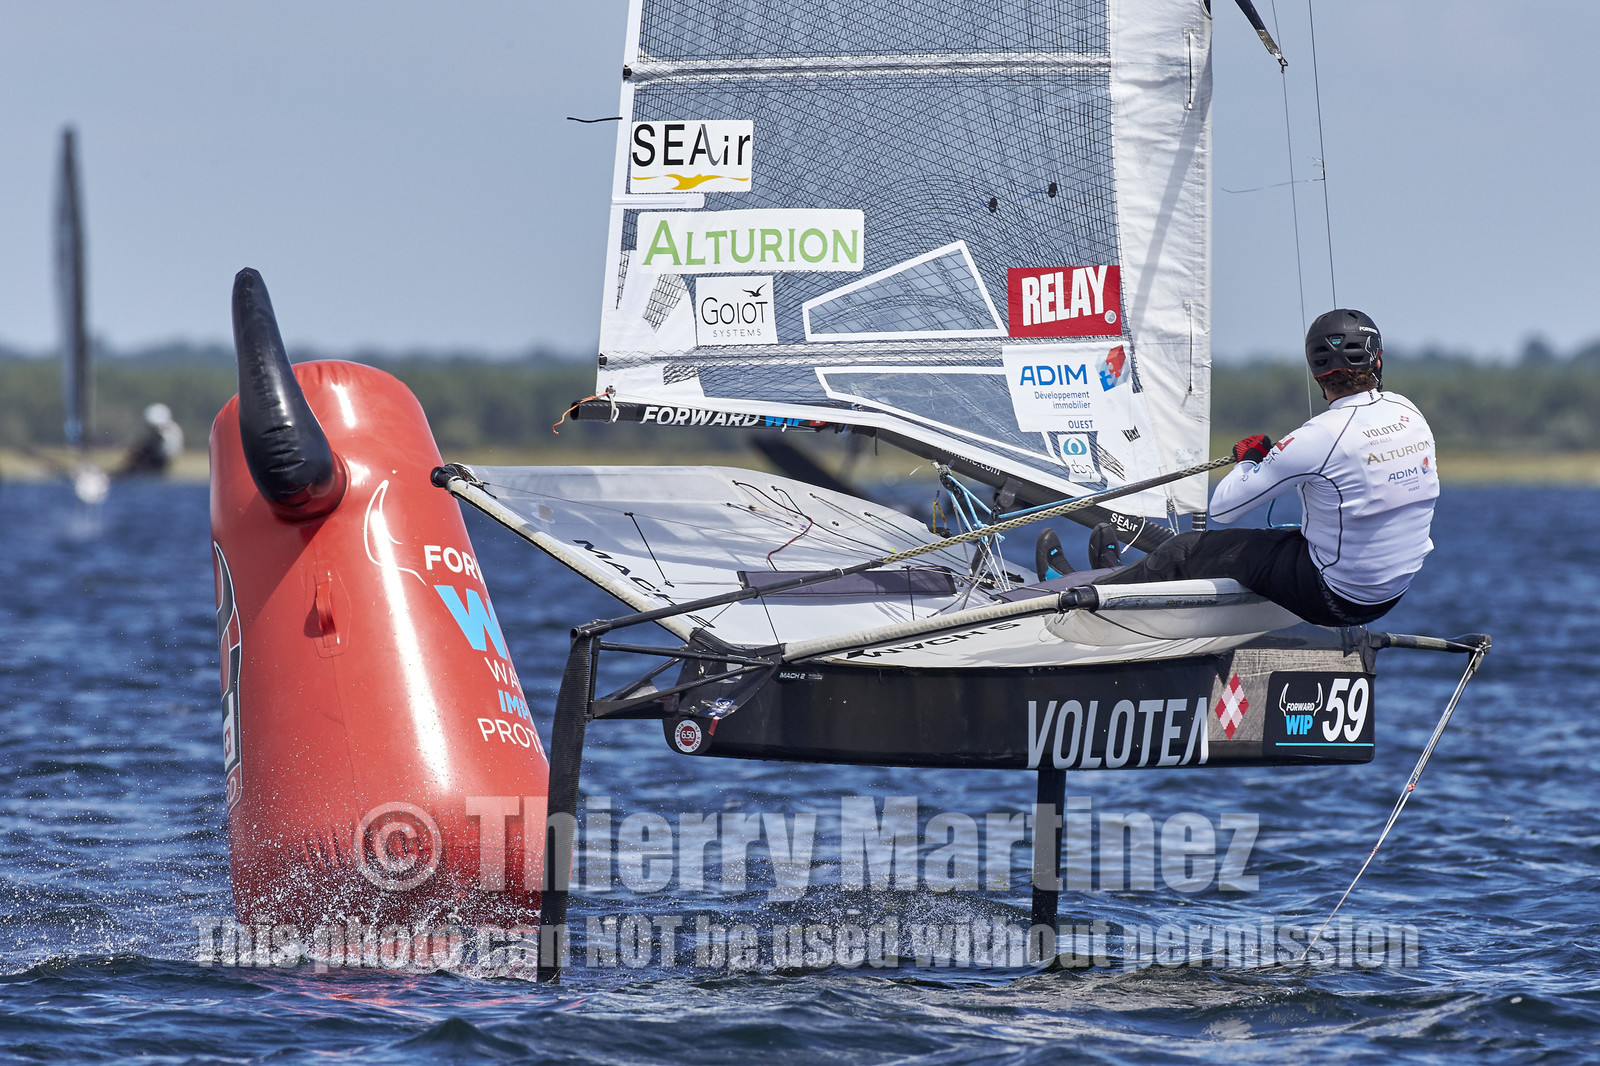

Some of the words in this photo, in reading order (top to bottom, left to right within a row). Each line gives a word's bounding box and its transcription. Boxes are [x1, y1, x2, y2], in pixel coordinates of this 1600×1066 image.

[632, 124, 751, 167] SEAir
[642, 220, 859, 266] ALTURION
[712, 328, 762, 338] SYSTEMS
[1019, 363, 1088, 386] ADIM
[1034, 390, 1090, 401] Développement
[1052, 400, 1091, 409] immobilier
[639, 405, 760, 427] FORWARD
[1068, 419, 1094, 429] OUEST
[1387, 466, 1418, 482] ADIM
[1110, 512, 1138, 532] SEAir
[779, 671, 800, 679] MACH
[800, 672, 806, 680] 2
[1286, 702, 1315, 712] FORWARD
[1322, 677, 1370, 742] 59
[1027, 697, 1210, 769] VOLOTEA
[1285, 714, 1314, 735] WIP
